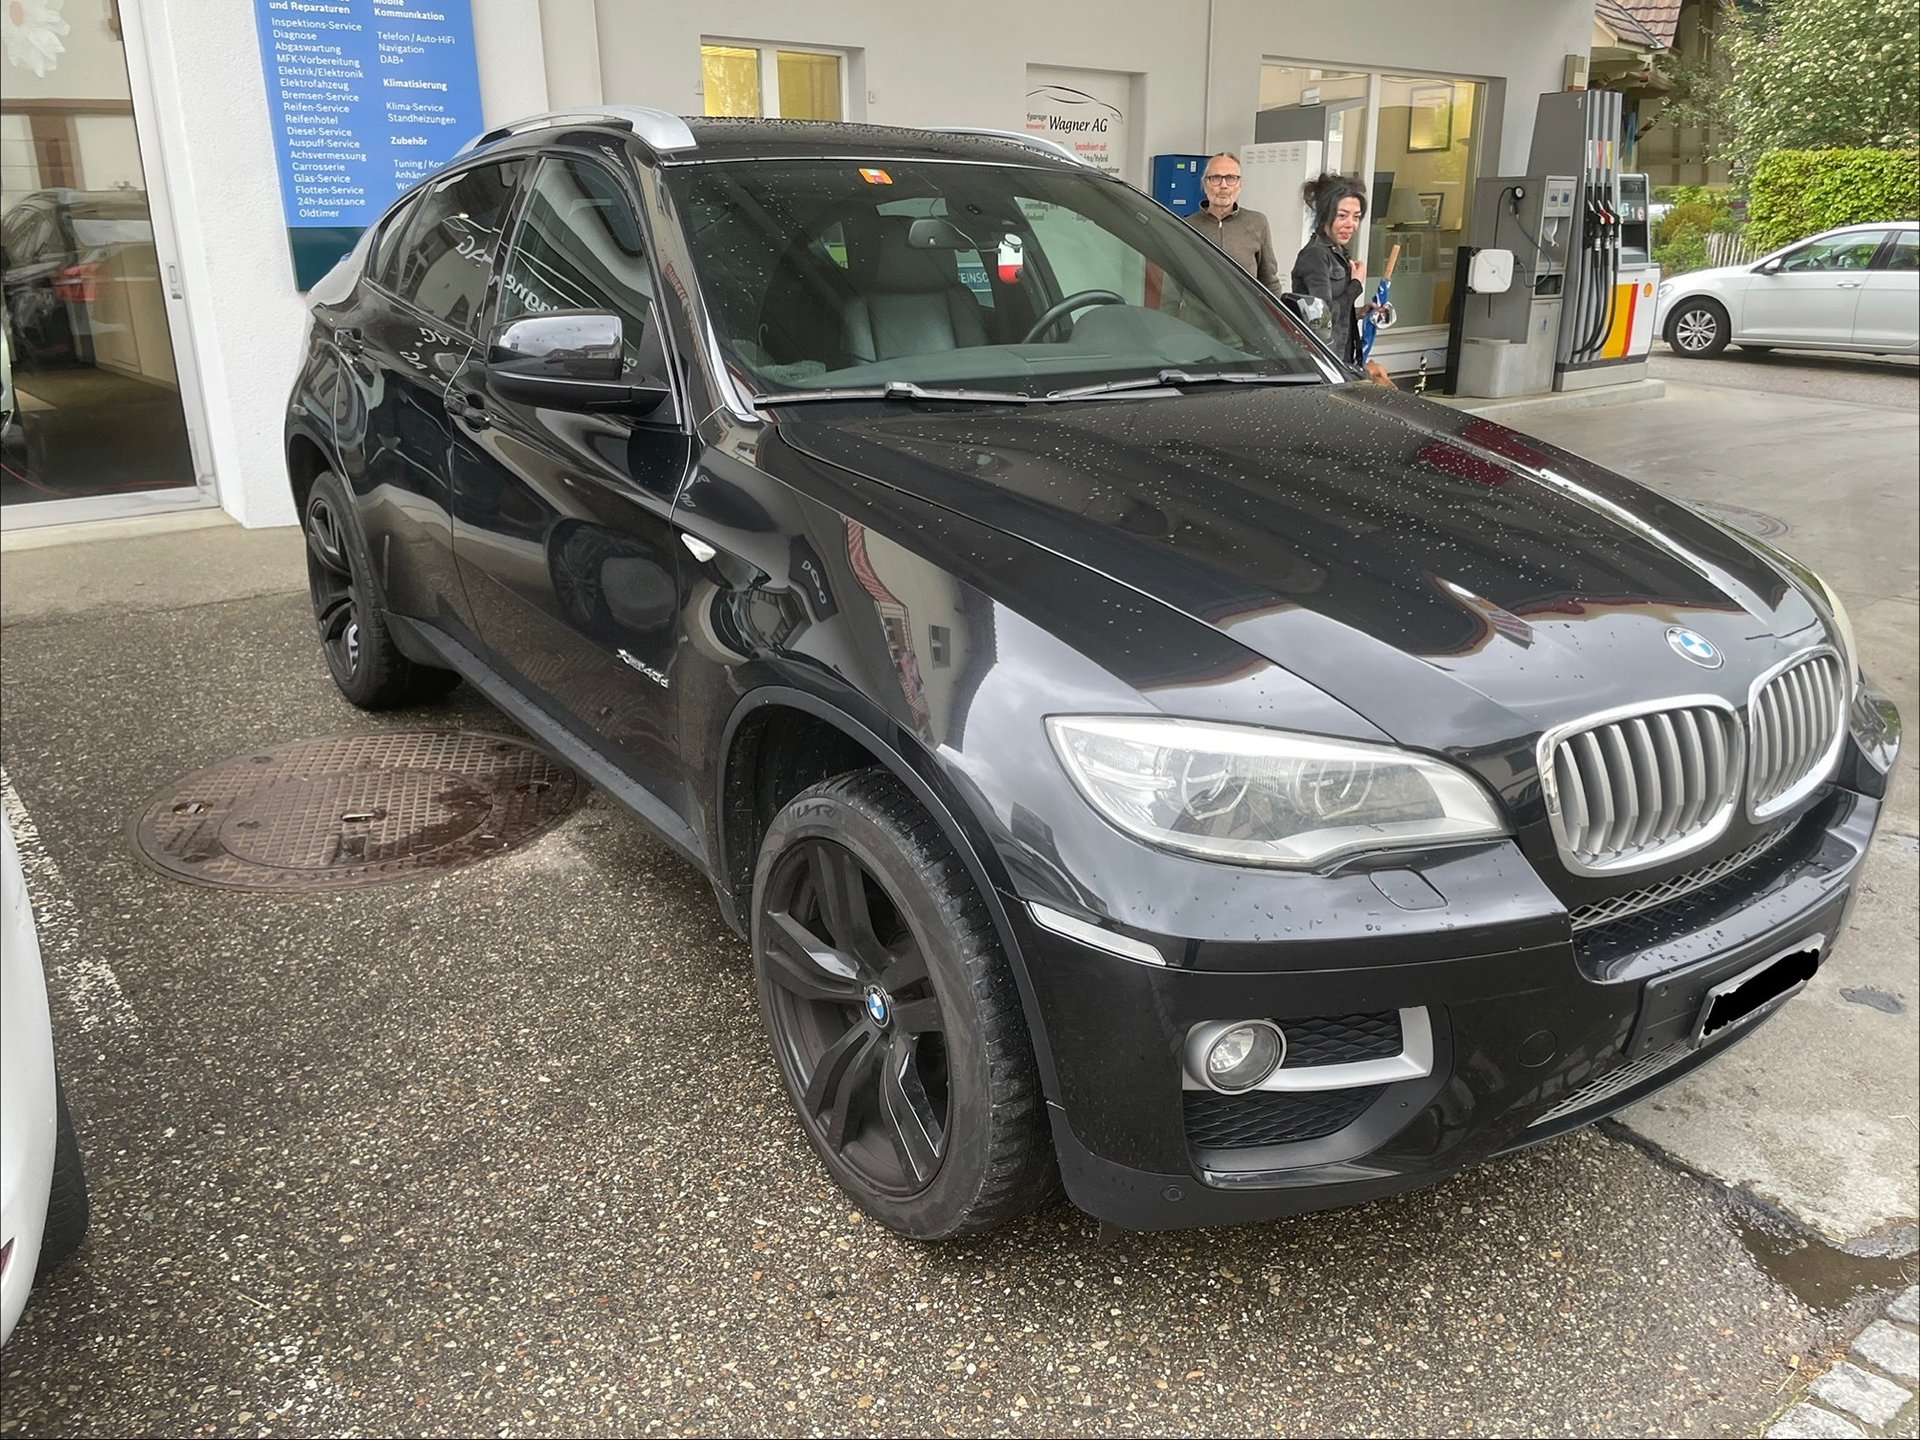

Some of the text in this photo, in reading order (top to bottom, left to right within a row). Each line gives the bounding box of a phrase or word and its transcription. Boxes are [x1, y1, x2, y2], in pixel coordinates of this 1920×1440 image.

[269, 1, 350, 14] und Reparaturen
[374, 8, 445, 21] Kommunikation
[271, 17, 362, 31] Inspektions-Service
[273, 29, 317, 41] Diagnose
[377, 31, 410, 42] Telefon
[275, 42, 341, 55] Abgaswartung
[378, 43, 424, 54] Navigation
[276, 54, 360, 68] MFK-Vorbereitung
[380, 55, 404, 64] DAB+
[278, 66, 364, 79] Elektrik/Elektronik
[383, 78, 448, 92] Klimatisierung
[281, 90, 359, 102] Bremsen-Service
[283, 102, 350, 114] Reifen-Service
[386, 102, 444, 113] Klima-Service
[285, 114, 338, 126] Reifenhotel
[388, 114, 456, 125] Standheizungen
[1049, 115, 1108, 134] Wagner AG
[286, 126, 352, 137] Diesel-Service
[288, 138, 360, 149] Auspuff-Service
[390, 136, 428, 146] Zubehör
[290, 150, 367, 162] Achsvermessung
[292, 162, 345, 172] Carrosserie
[394, 159, 422, 170] Tuning
[293, 173, 350, 183] Glas-Service
[295, 185, 364, 195] Flotten-Service
[297, 197, 365, 207] 24h-Assistance
[299, 208, 340, 218] Oldtimer
